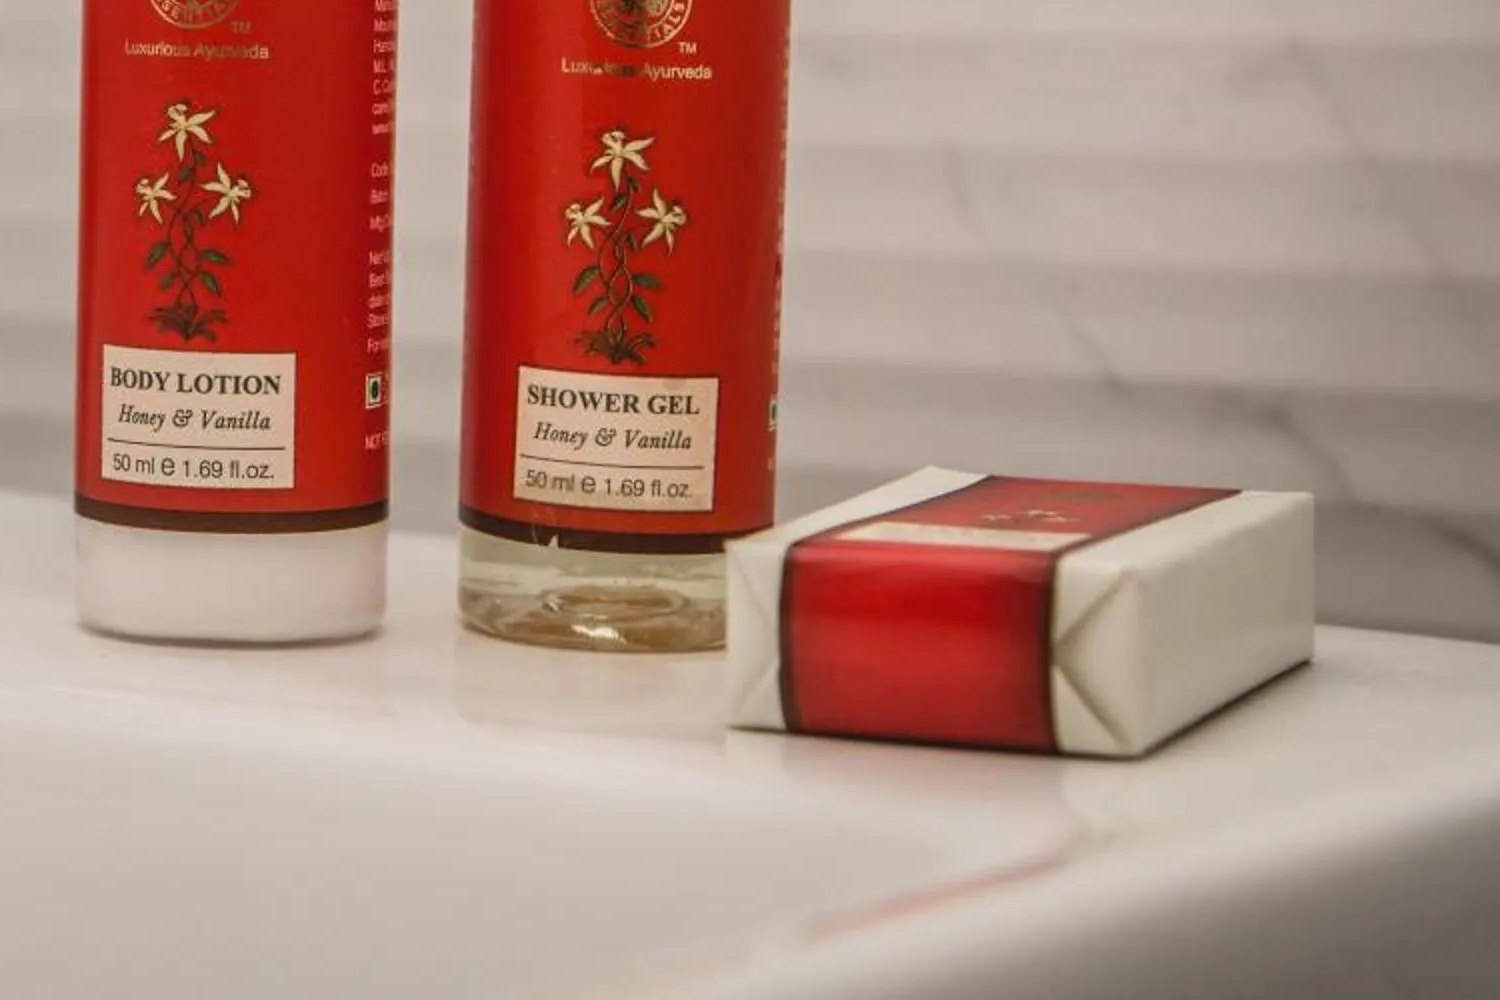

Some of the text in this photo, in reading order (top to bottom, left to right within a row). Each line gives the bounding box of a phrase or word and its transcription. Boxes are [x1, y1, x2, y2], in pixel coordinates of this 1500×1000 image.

[677, 41, 698, 54] TM
[642, 61, 713, 82] Ayurveda
[110, 366, 282, 396] BODY LOTION
[527, 383, 701, 415] SHOWER GEL
[117, 403, 272, 433] Honey & Vanilla
[533, 421, 693, 450] Honey & Vanilla
[112, 452, 132, 473] 50
[135, 456, 156, 475] ml
[182, 459, 224, 479] 1.69
[525, 468, 548, 489] 50
[551, 473, 575, 493] ml
[604, 478, 646, 498] 1.69
